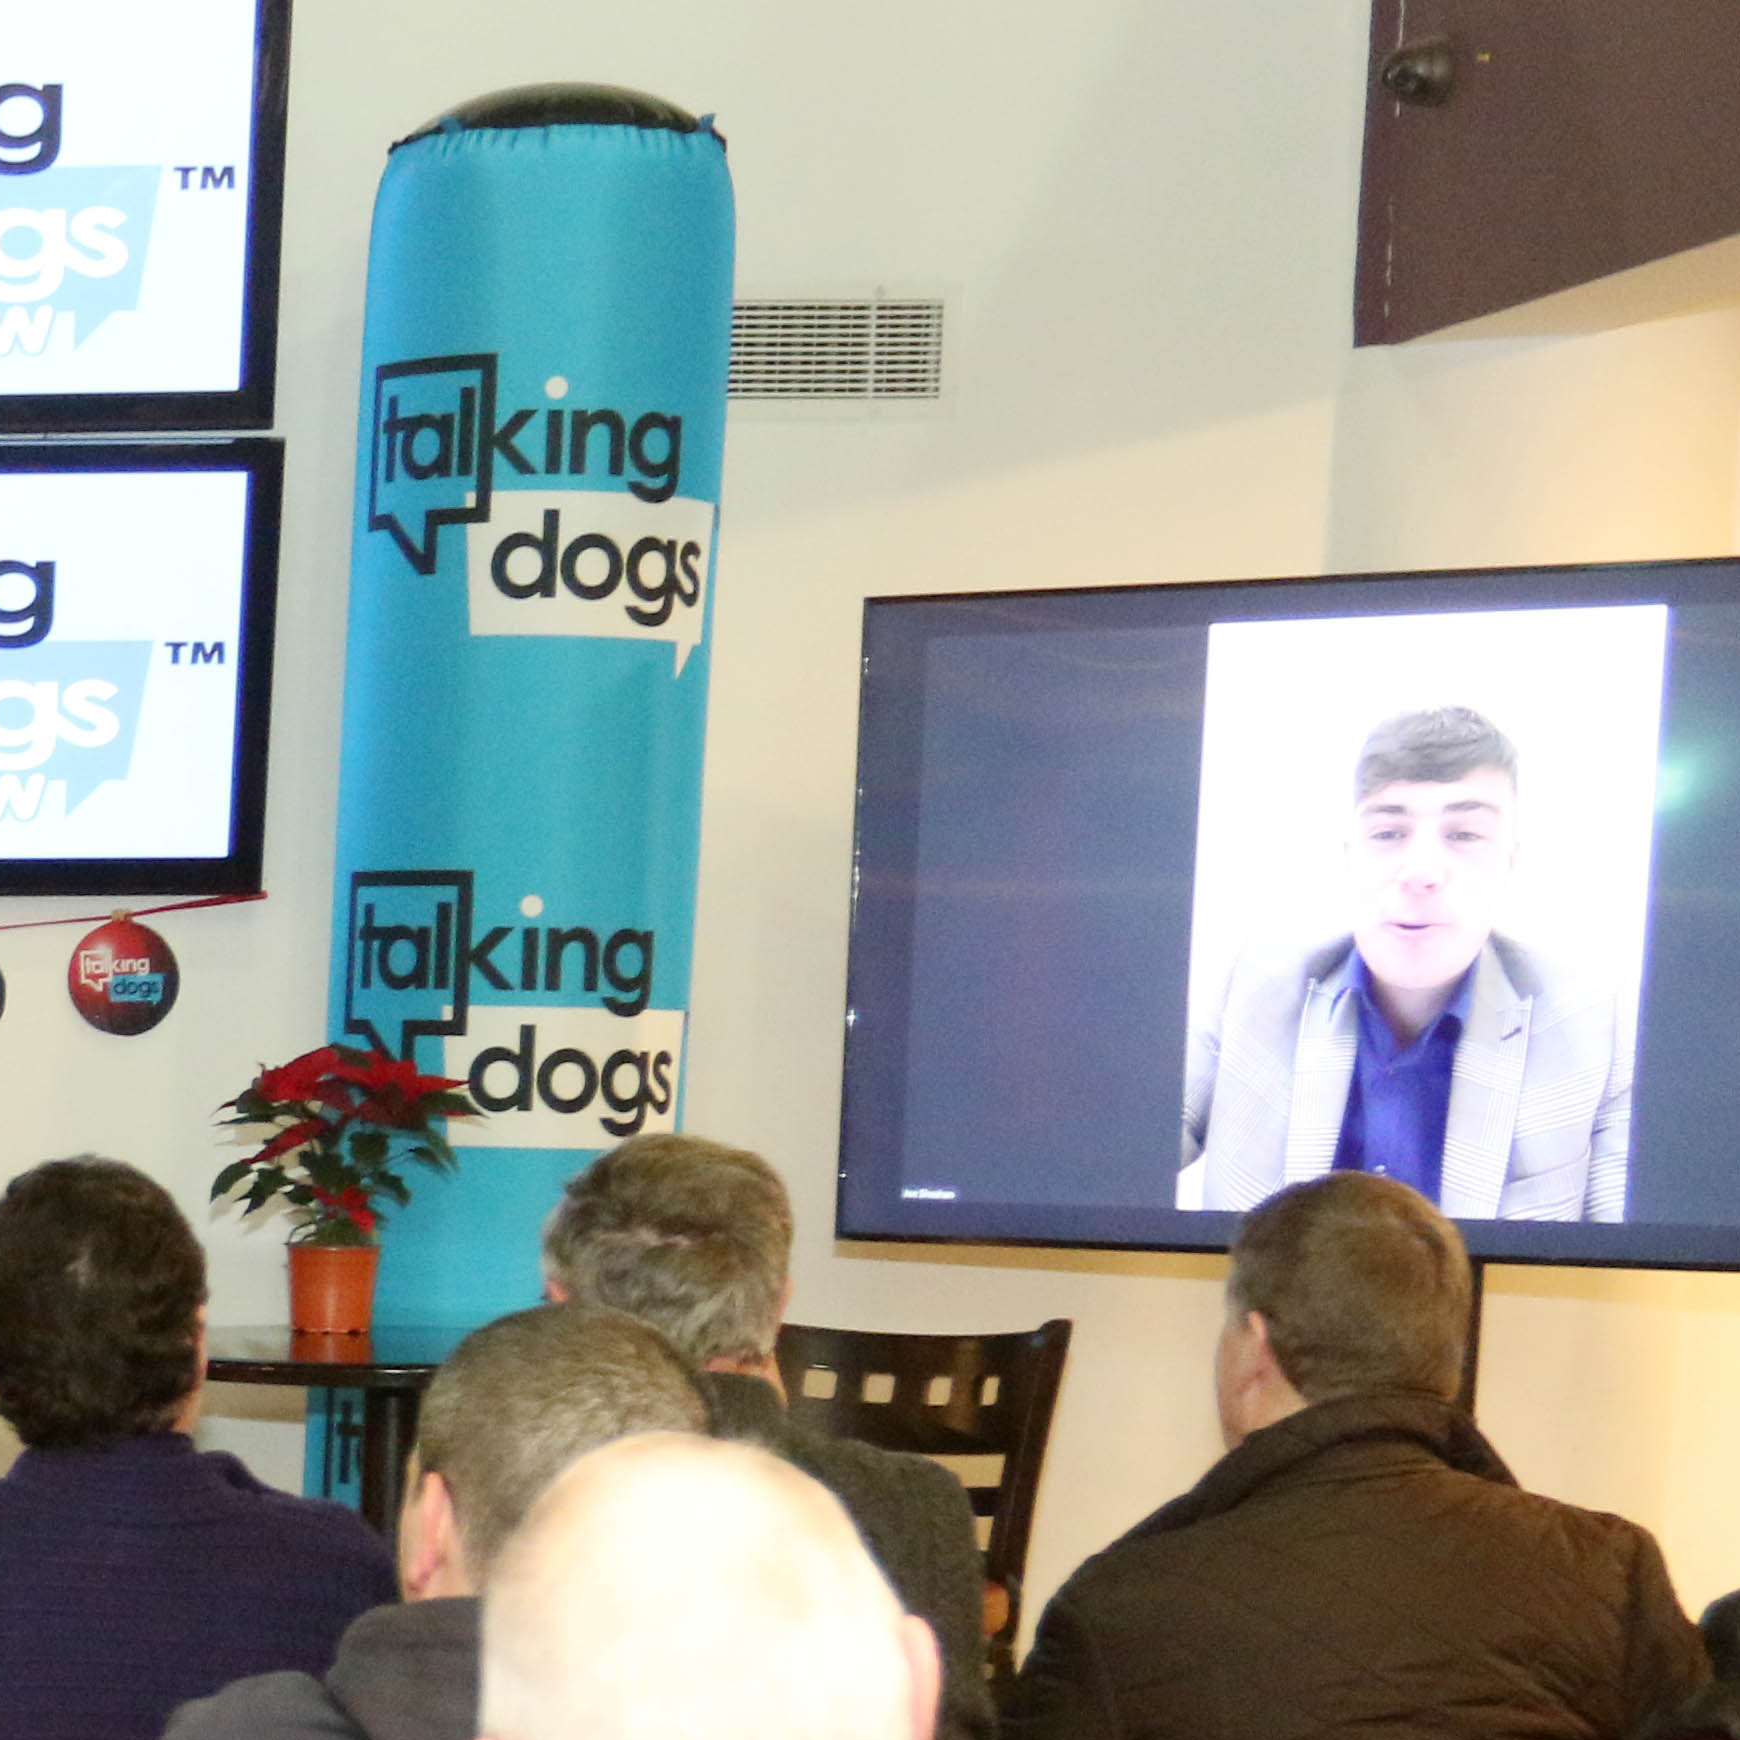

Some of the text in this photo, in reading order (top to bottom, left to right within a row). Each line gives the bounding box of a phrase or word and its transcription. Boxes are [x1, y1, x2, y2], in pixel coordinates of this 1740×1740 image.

[174, 166, 236, 190] TM
[383, 375, 682, 503] talking
[491, 508, 701, 627] dogs
[165, 641, 226, 665] TM
[86, 954, 151, 976] talking
[358, 894, 656, 1018] talking
[468, 1024, 673, 1137] dogs
